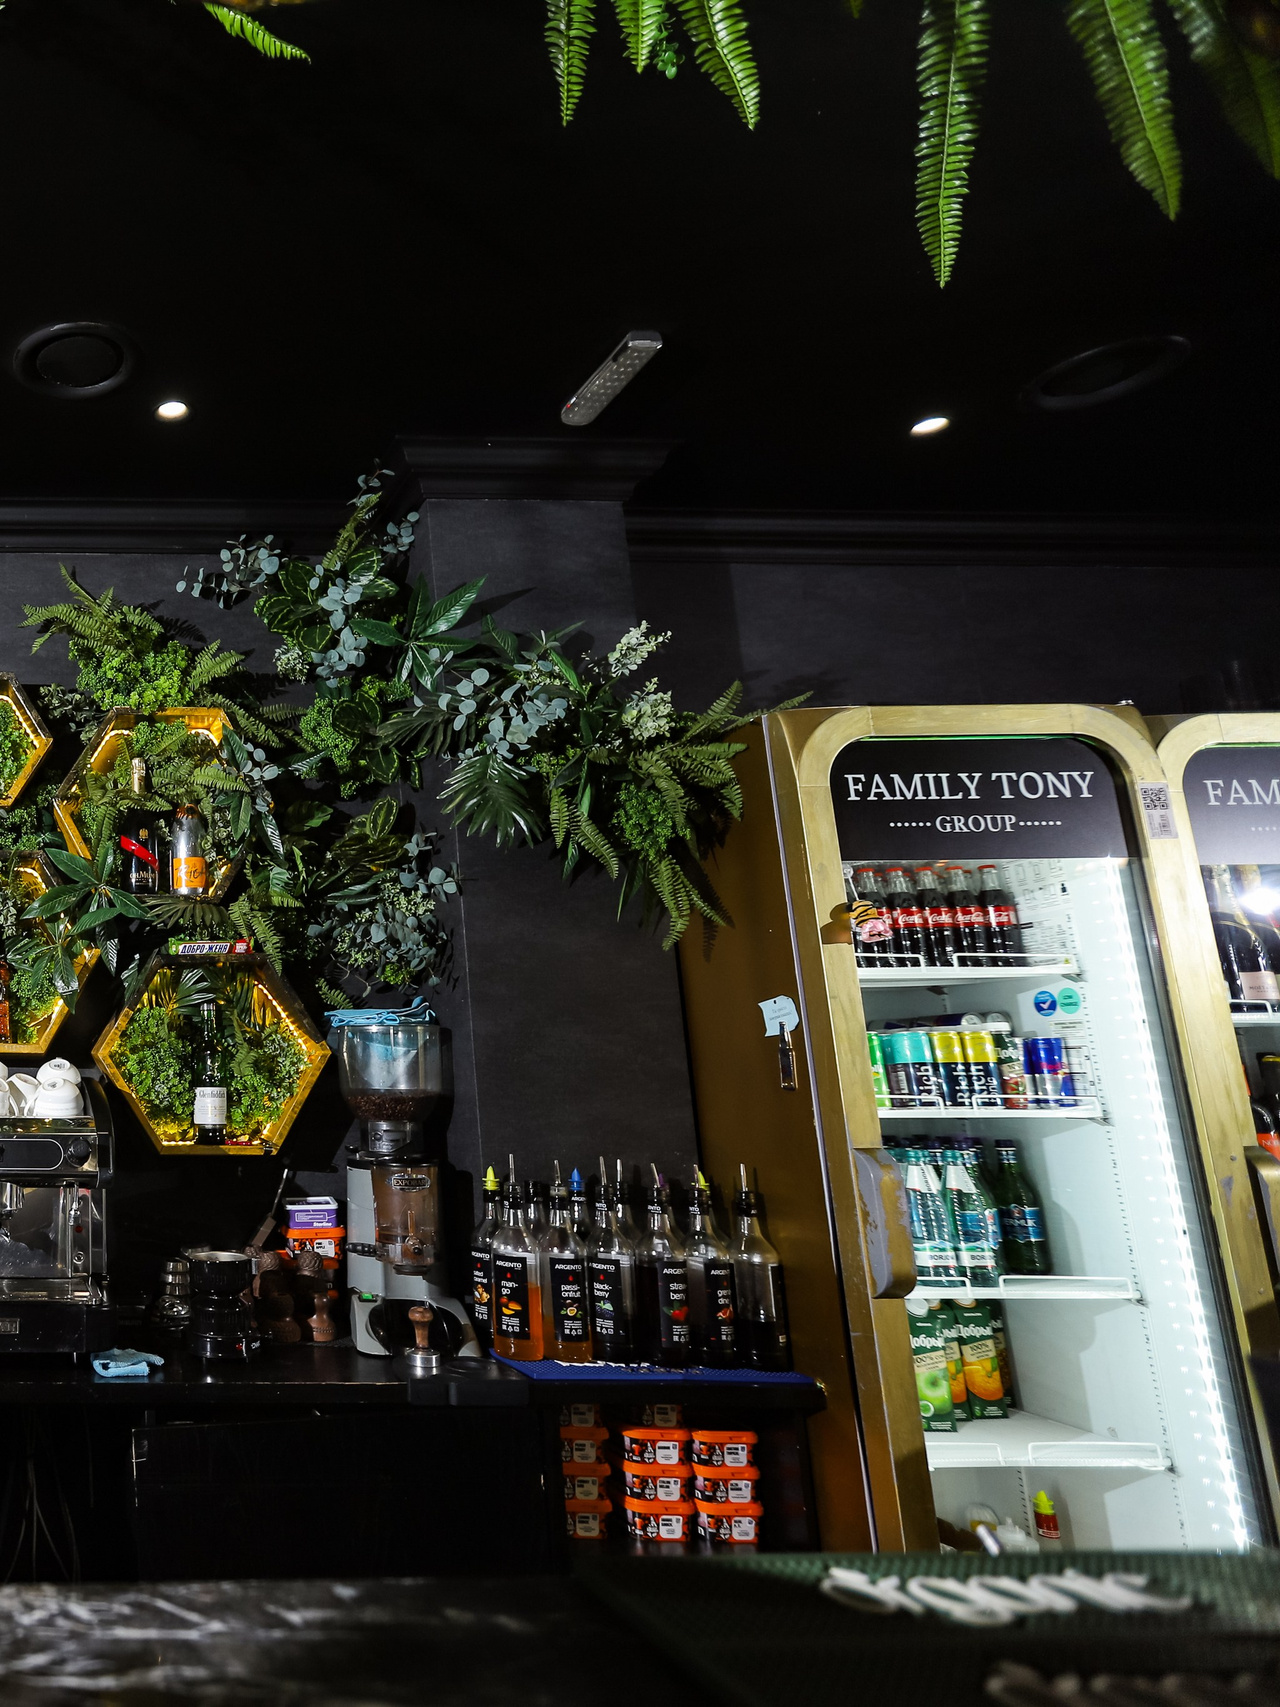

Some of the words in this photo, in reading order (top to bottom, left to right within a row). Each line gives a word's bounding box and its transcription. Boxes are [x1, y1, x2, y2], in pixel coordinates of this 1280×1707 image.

[844, 772, 982, 800] FAMILY
[991, 771, 1094, 799] TONY
[935, 814, 1017, 833] GROUP
[496, 1260, 522, 1268] ARGENTO
[554, 1263, 582, 1271] ARGENTO
[594, 1289, 610, 1298] berry
